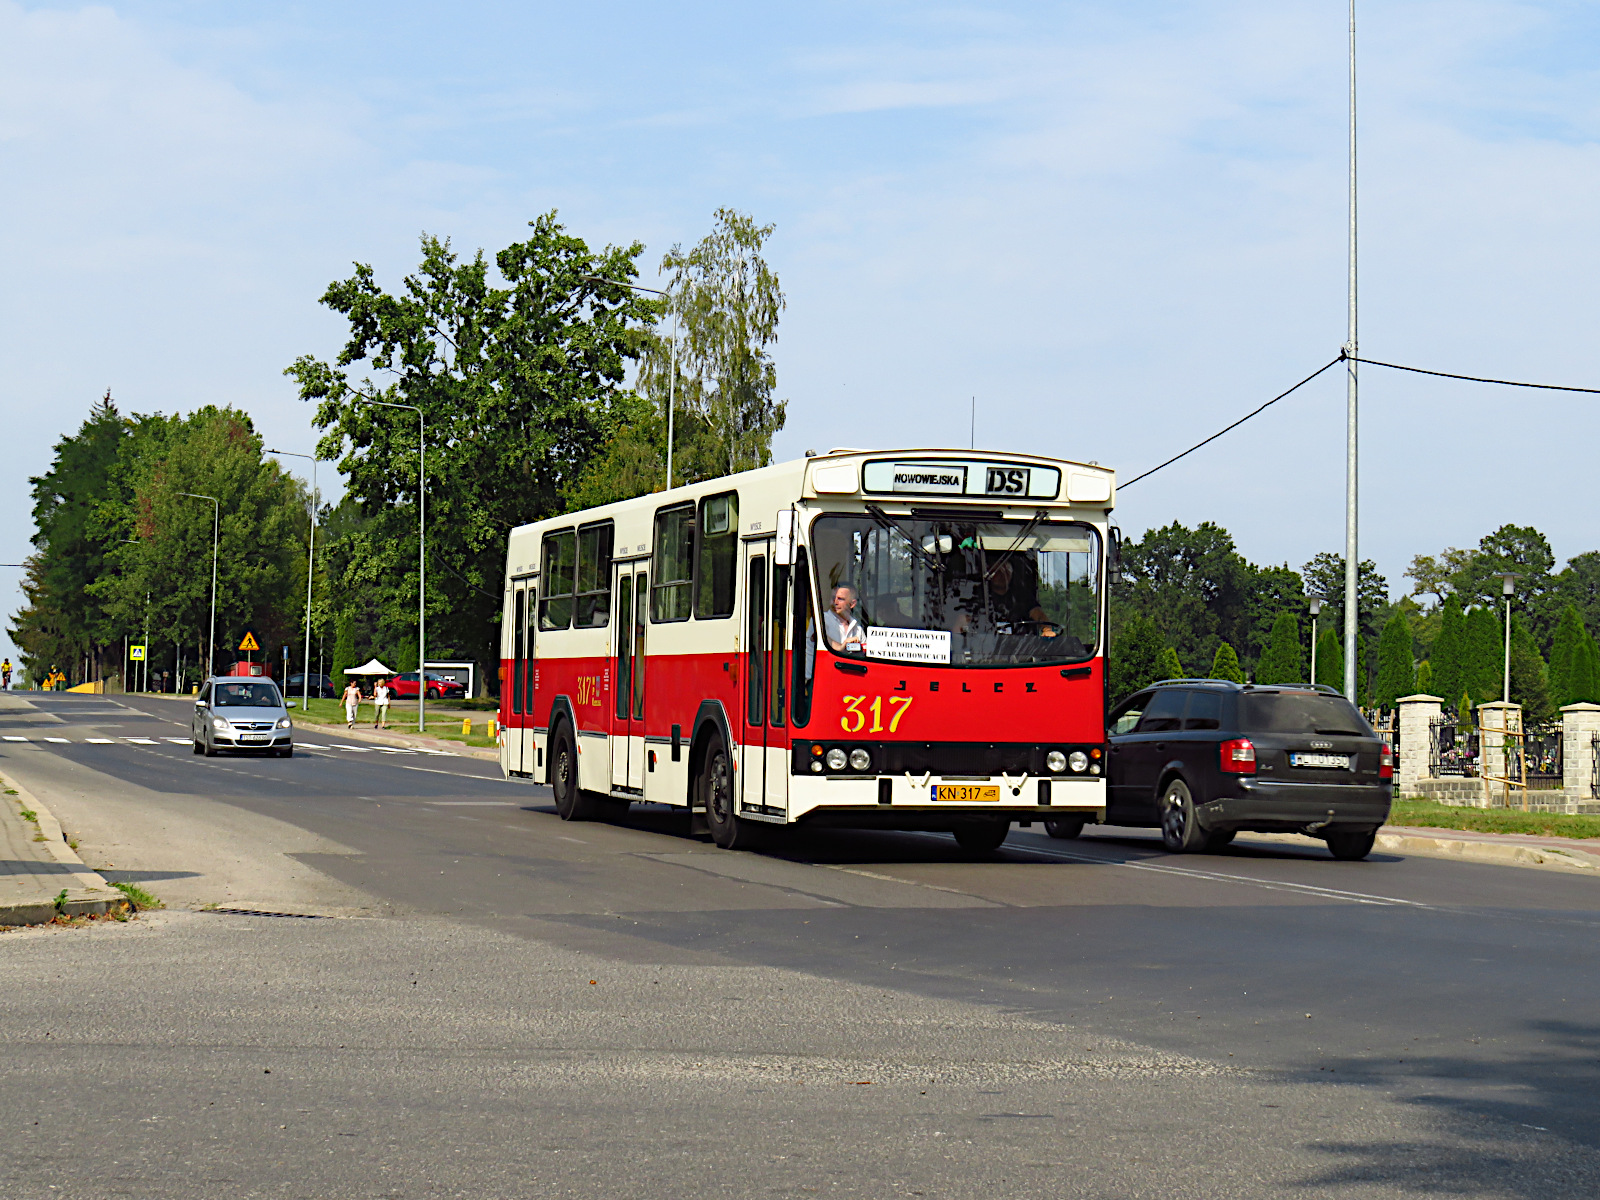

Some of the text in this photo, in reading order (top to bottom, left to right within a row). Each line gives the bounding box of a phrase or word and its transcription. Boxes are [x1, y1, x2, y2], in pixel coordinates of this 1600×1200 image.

[895, 474, 959, 485] NOWOWIEJSKA
[988, 471, 1023, 493] DS
[890, 632, 946, 640] ZABYTKOWYCH
[877, 651, 946, 660] STARACHOWICACH
[577, 676, 591, 705] 317
[894, 681, 1037, 693] JELCZ
[841, 695, 913, 733] 317
[939, 787, 981, 800] KN 317
